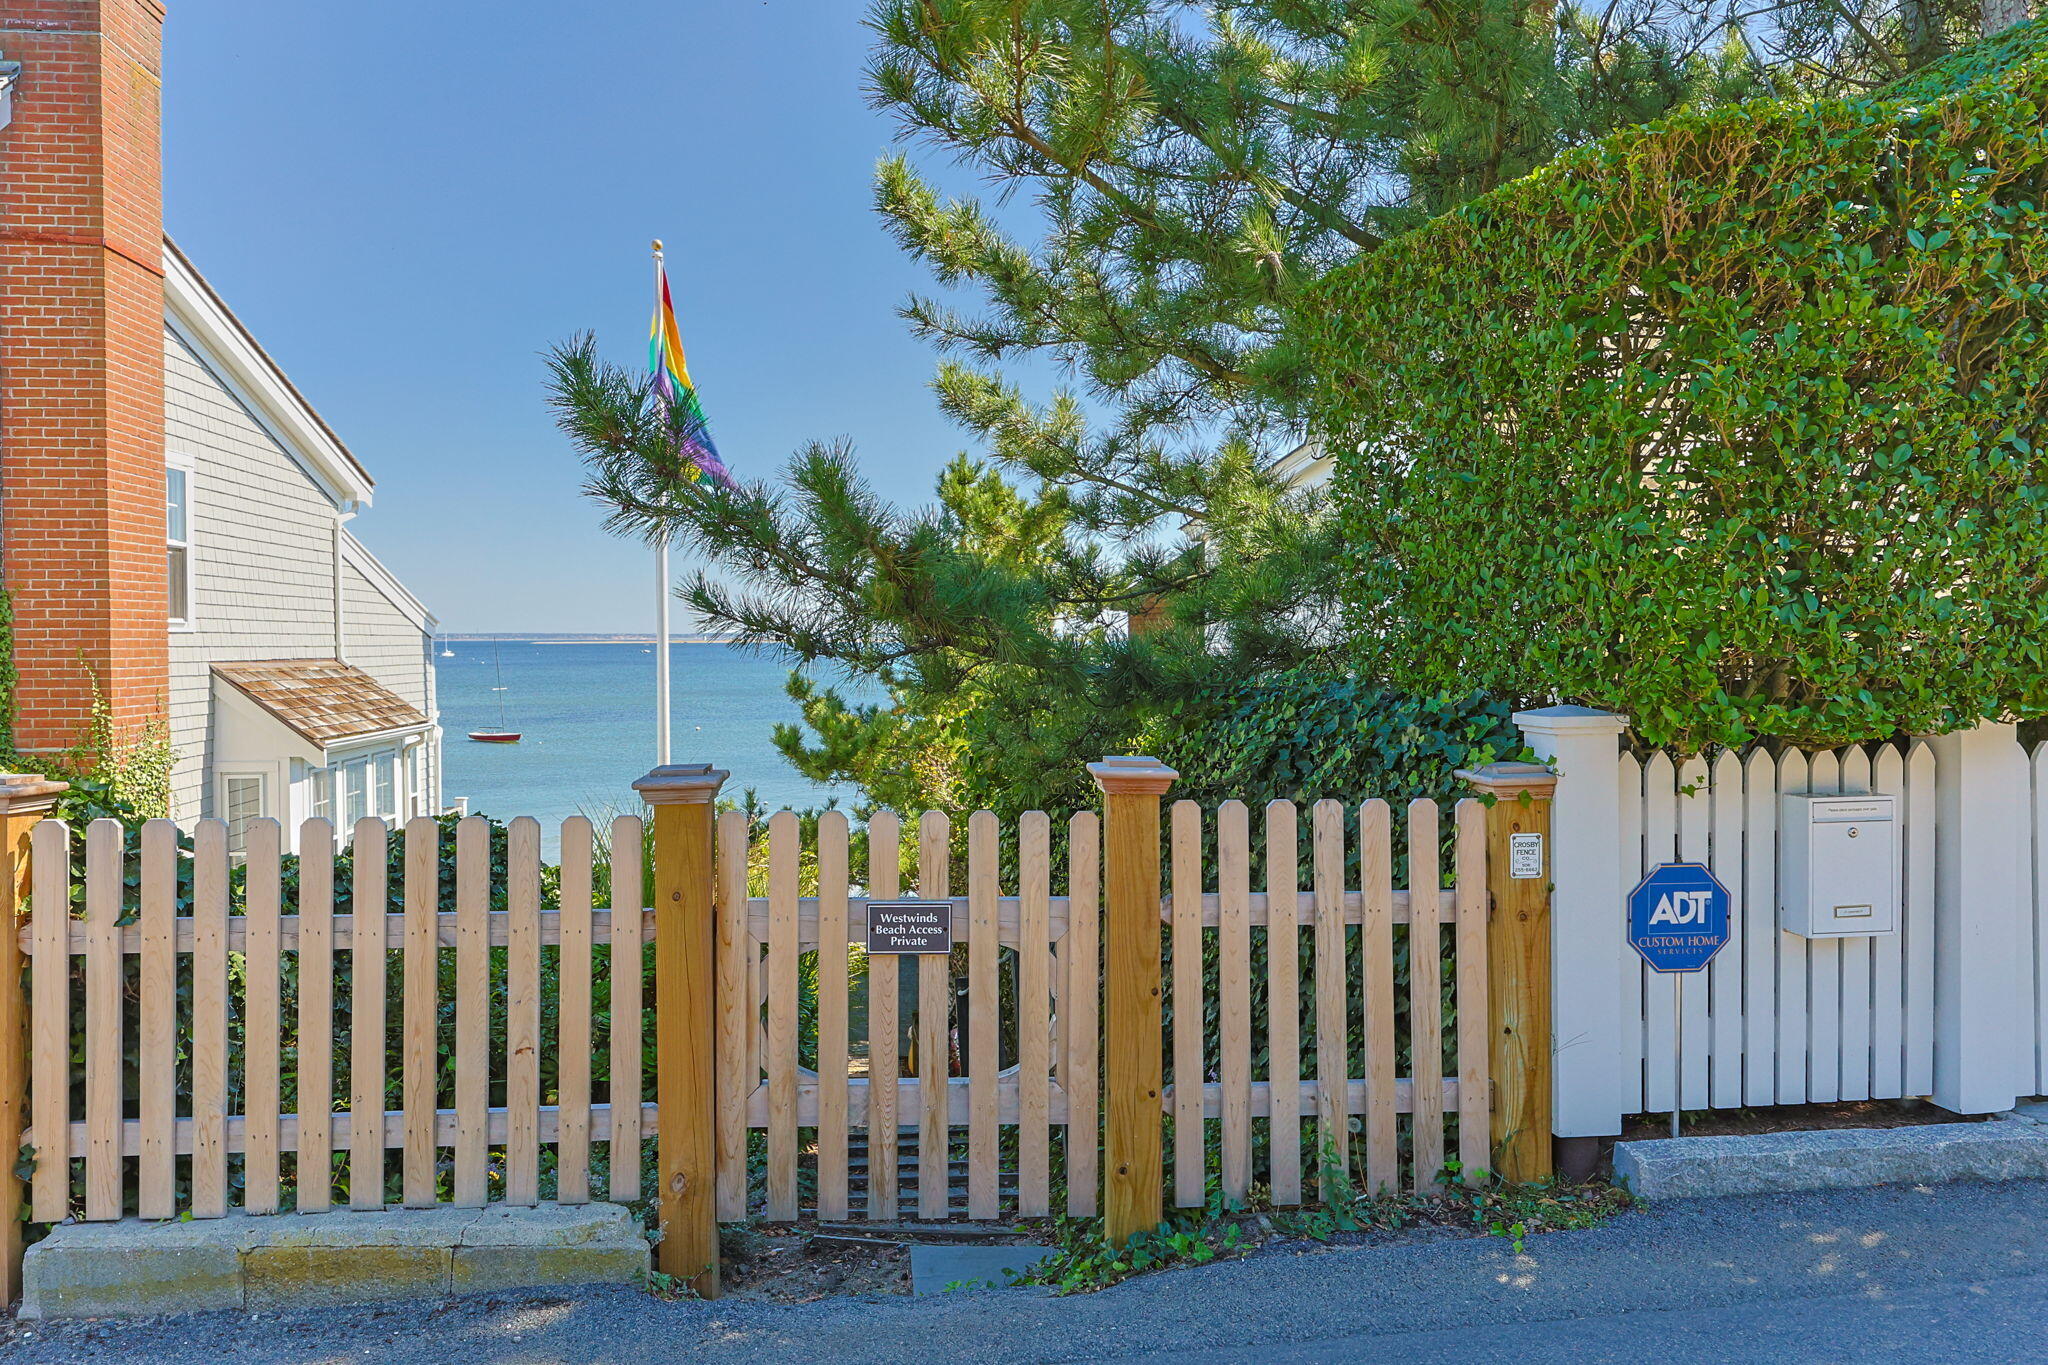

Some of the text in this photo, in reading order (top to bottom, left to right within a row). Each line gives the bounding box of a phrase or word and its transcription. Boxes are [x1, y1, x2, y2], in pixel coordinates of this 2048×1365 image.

[1649, 891, 1712, 925] ADT
[880, 913, 938, 923] Westwinds
[876, 925, 943, 935] Beach Access
[890, 936, 928, 946] Private
[1638, 935, 1720, 948] CUSTOM HOME
[1657, 947, 1703, 955] SERVICES
